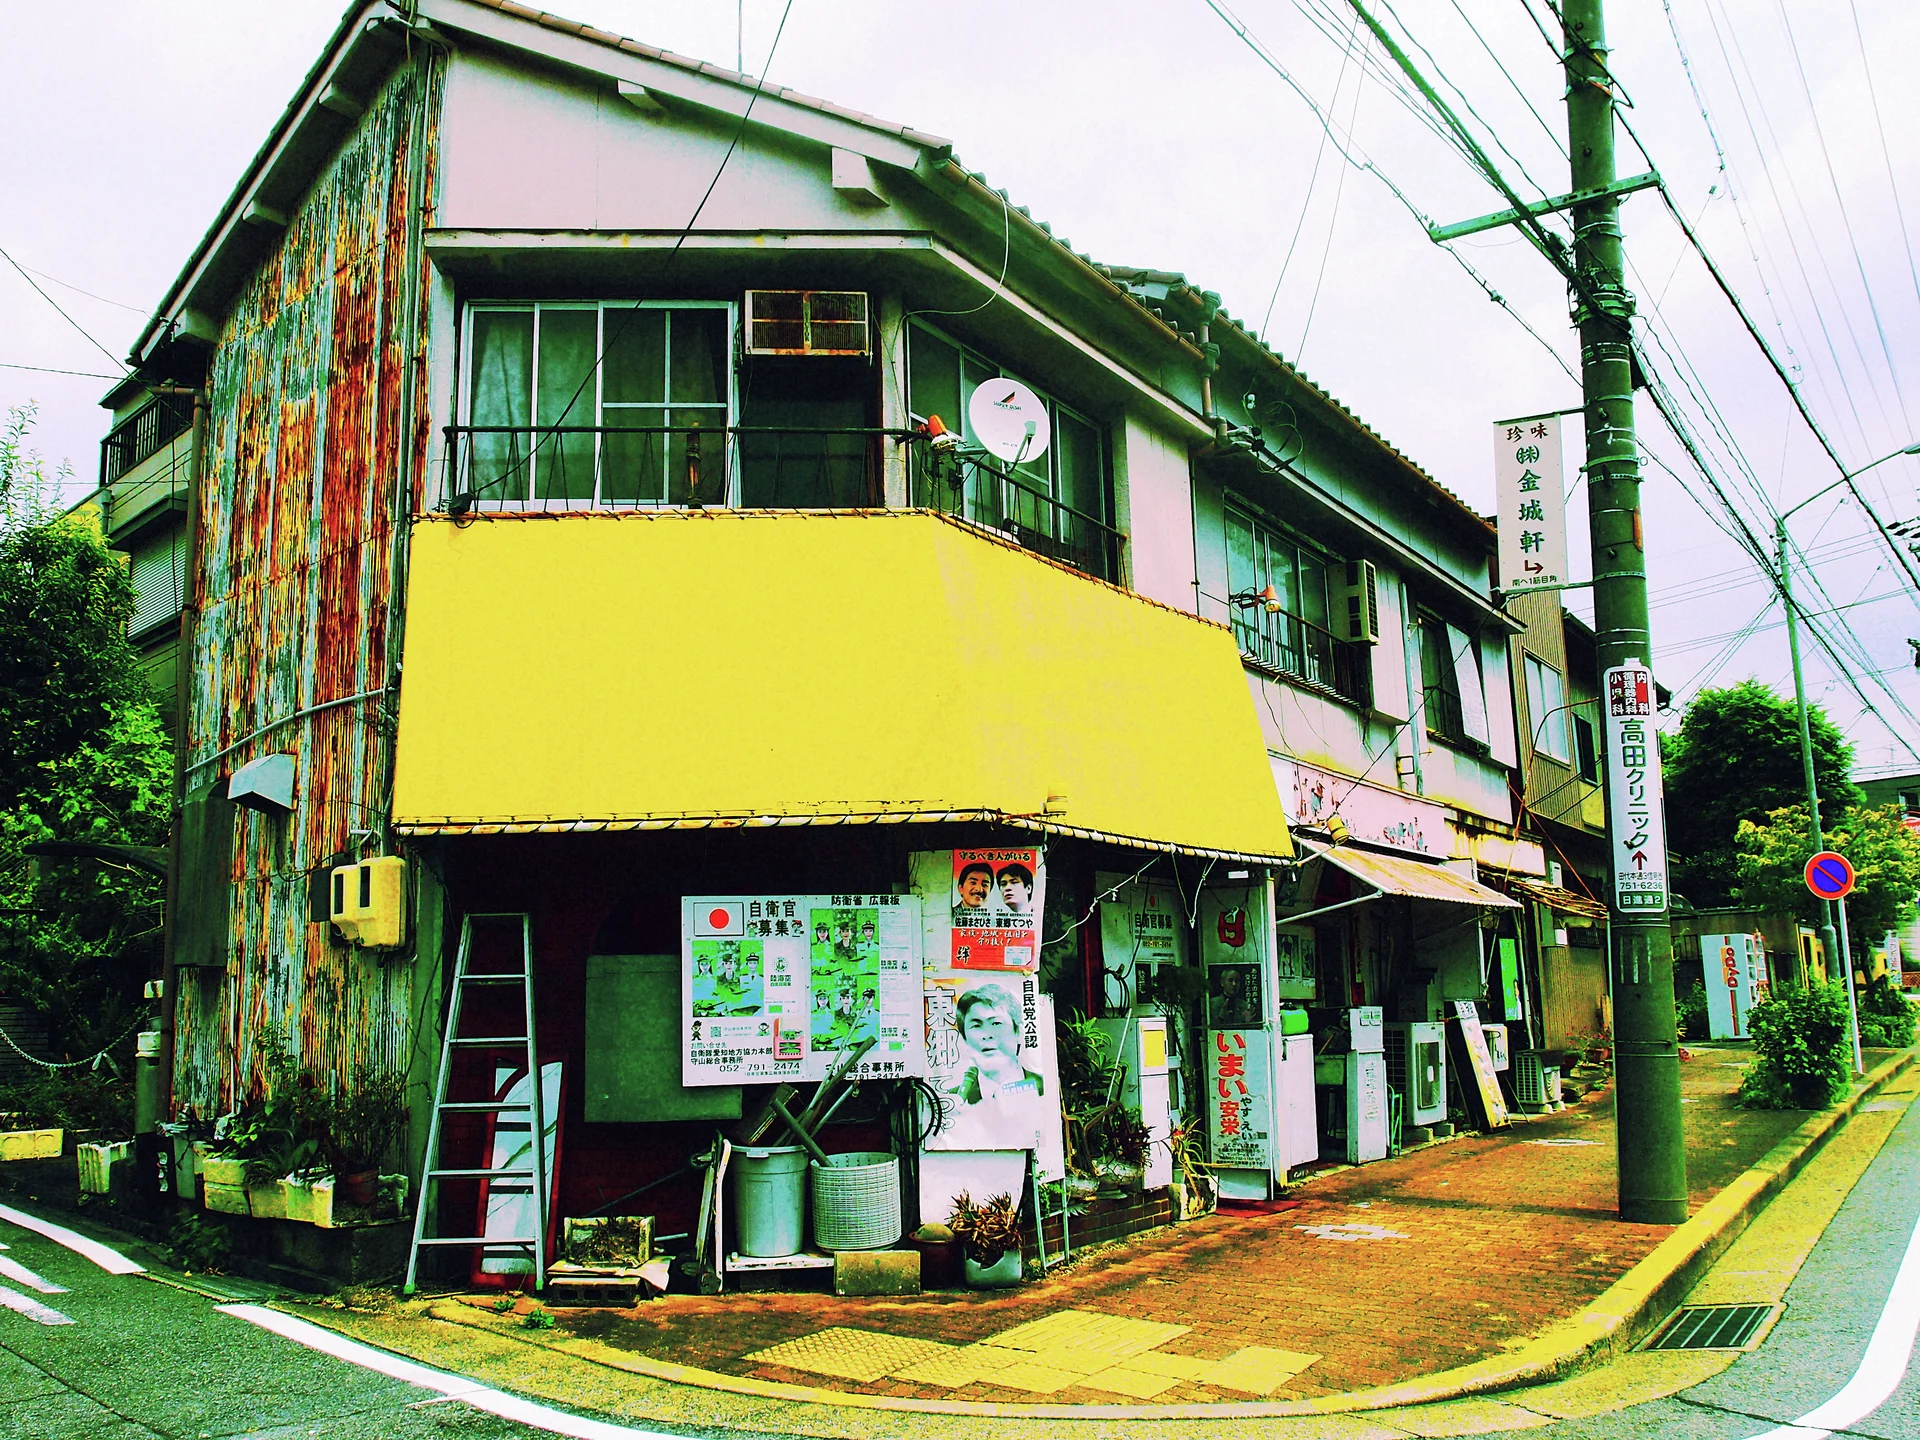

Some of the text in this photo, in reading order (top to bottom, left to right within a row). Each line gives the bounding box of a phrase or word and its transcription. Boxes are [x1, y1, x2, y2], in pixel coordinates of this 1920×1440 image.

[1506, 422, 1549, 443] 珍味
[1622, 671, 1638, 715] 循環器内科
[1636, 671, 1650, 715] 内科
[1619, 718, 1649, 849] 高田クリニック
[958, 851, 1031, 861] 守るべき人がいる
[1619, 882, 1663, 890] 751-6236
[750, 900, 796, 918] 自衛官
[758, 919, 790, 937] 募集
[954, 917, 1033, 928] 佐藤まさひさ 東郷てつや
[1725, 947, 1740, 988] DyDo
[1022, 979, 1038, 1049] 自民党公認
[690, 1047, 773, 1058] 自衛隊愛知地方協力本部
[690, 1056, 744, 1065] 守山総合事務所
[719, 1062, 800, 1073] 052-791-2474
[1240, 1097, 1252, 1140] やすえい
